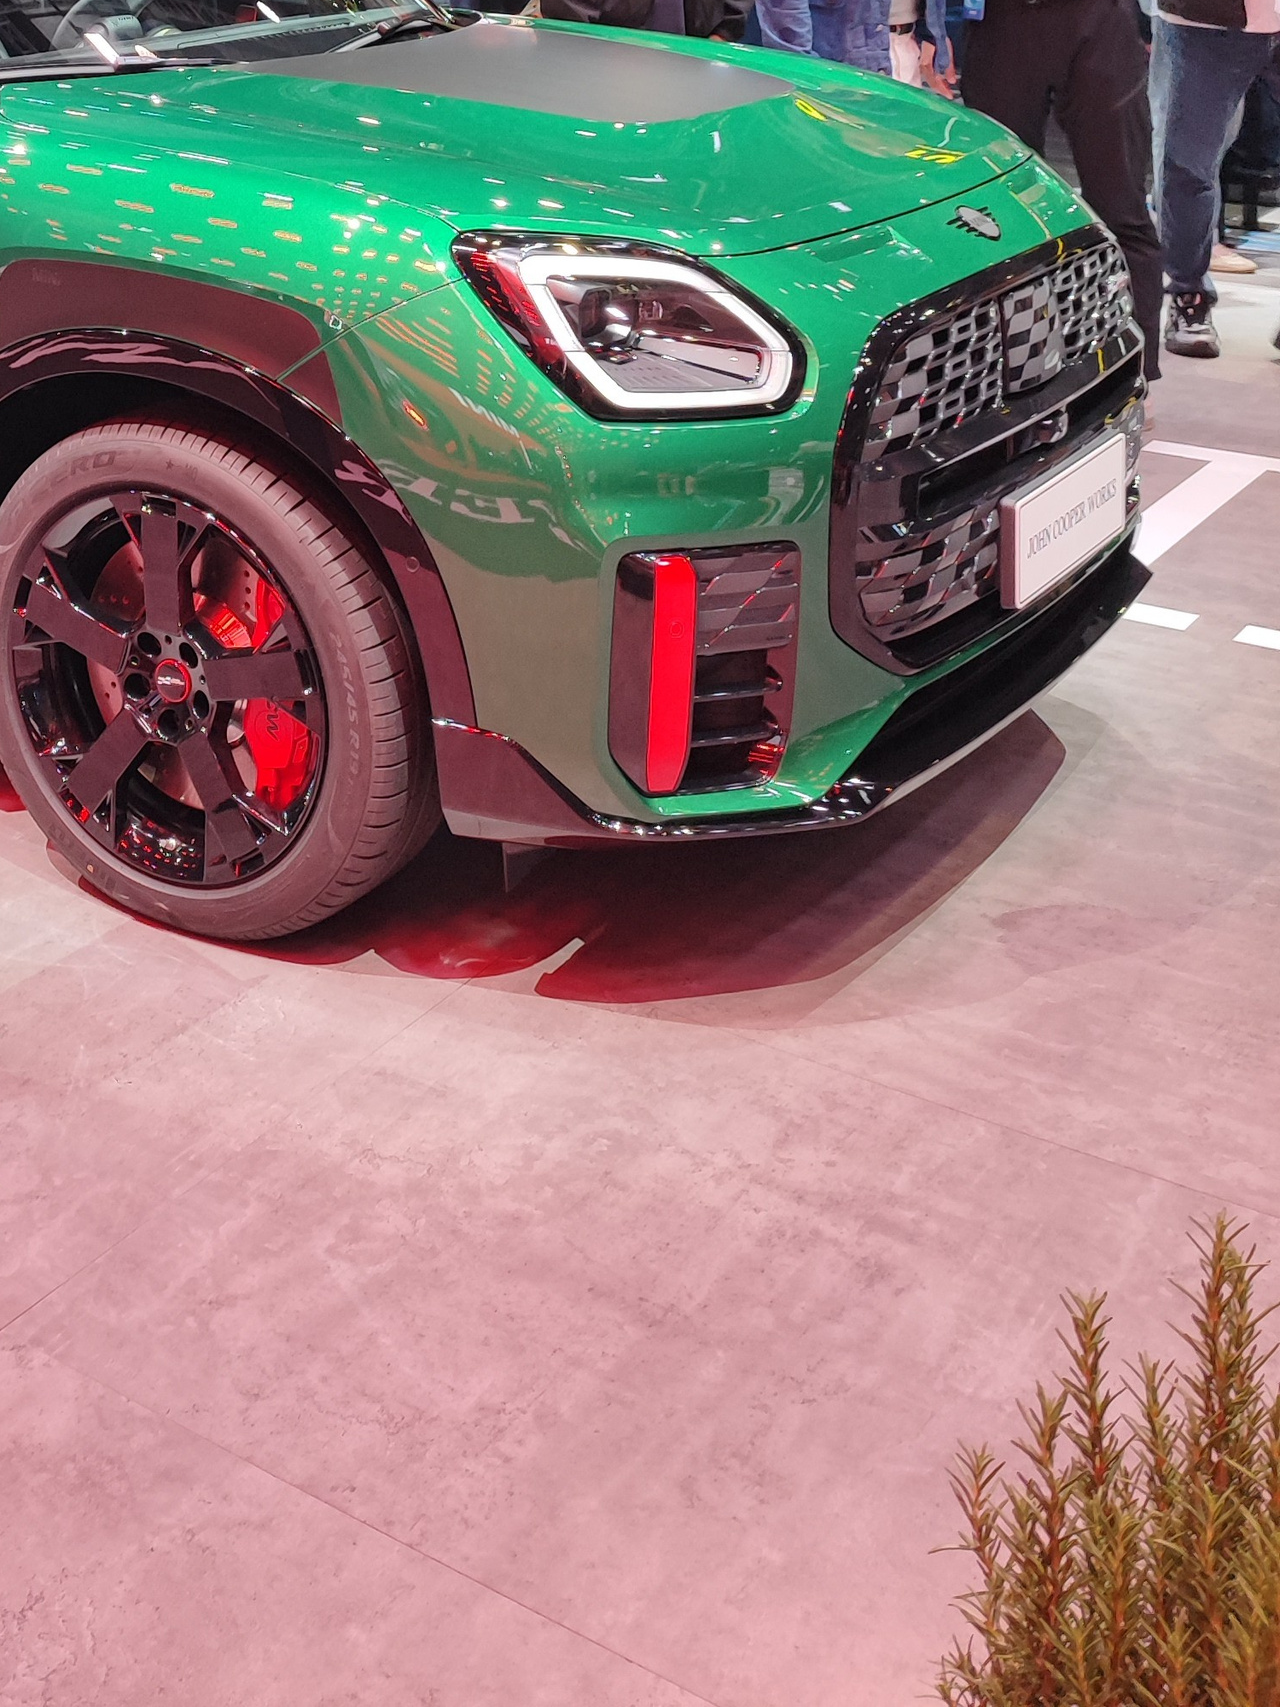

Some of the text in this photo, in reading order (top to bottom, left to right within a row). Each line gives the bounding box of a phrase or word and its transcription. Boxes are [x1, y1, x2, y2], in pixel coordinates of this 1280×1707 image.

[1026, 478, 1117, 559] JOHN COOPER WORKS
